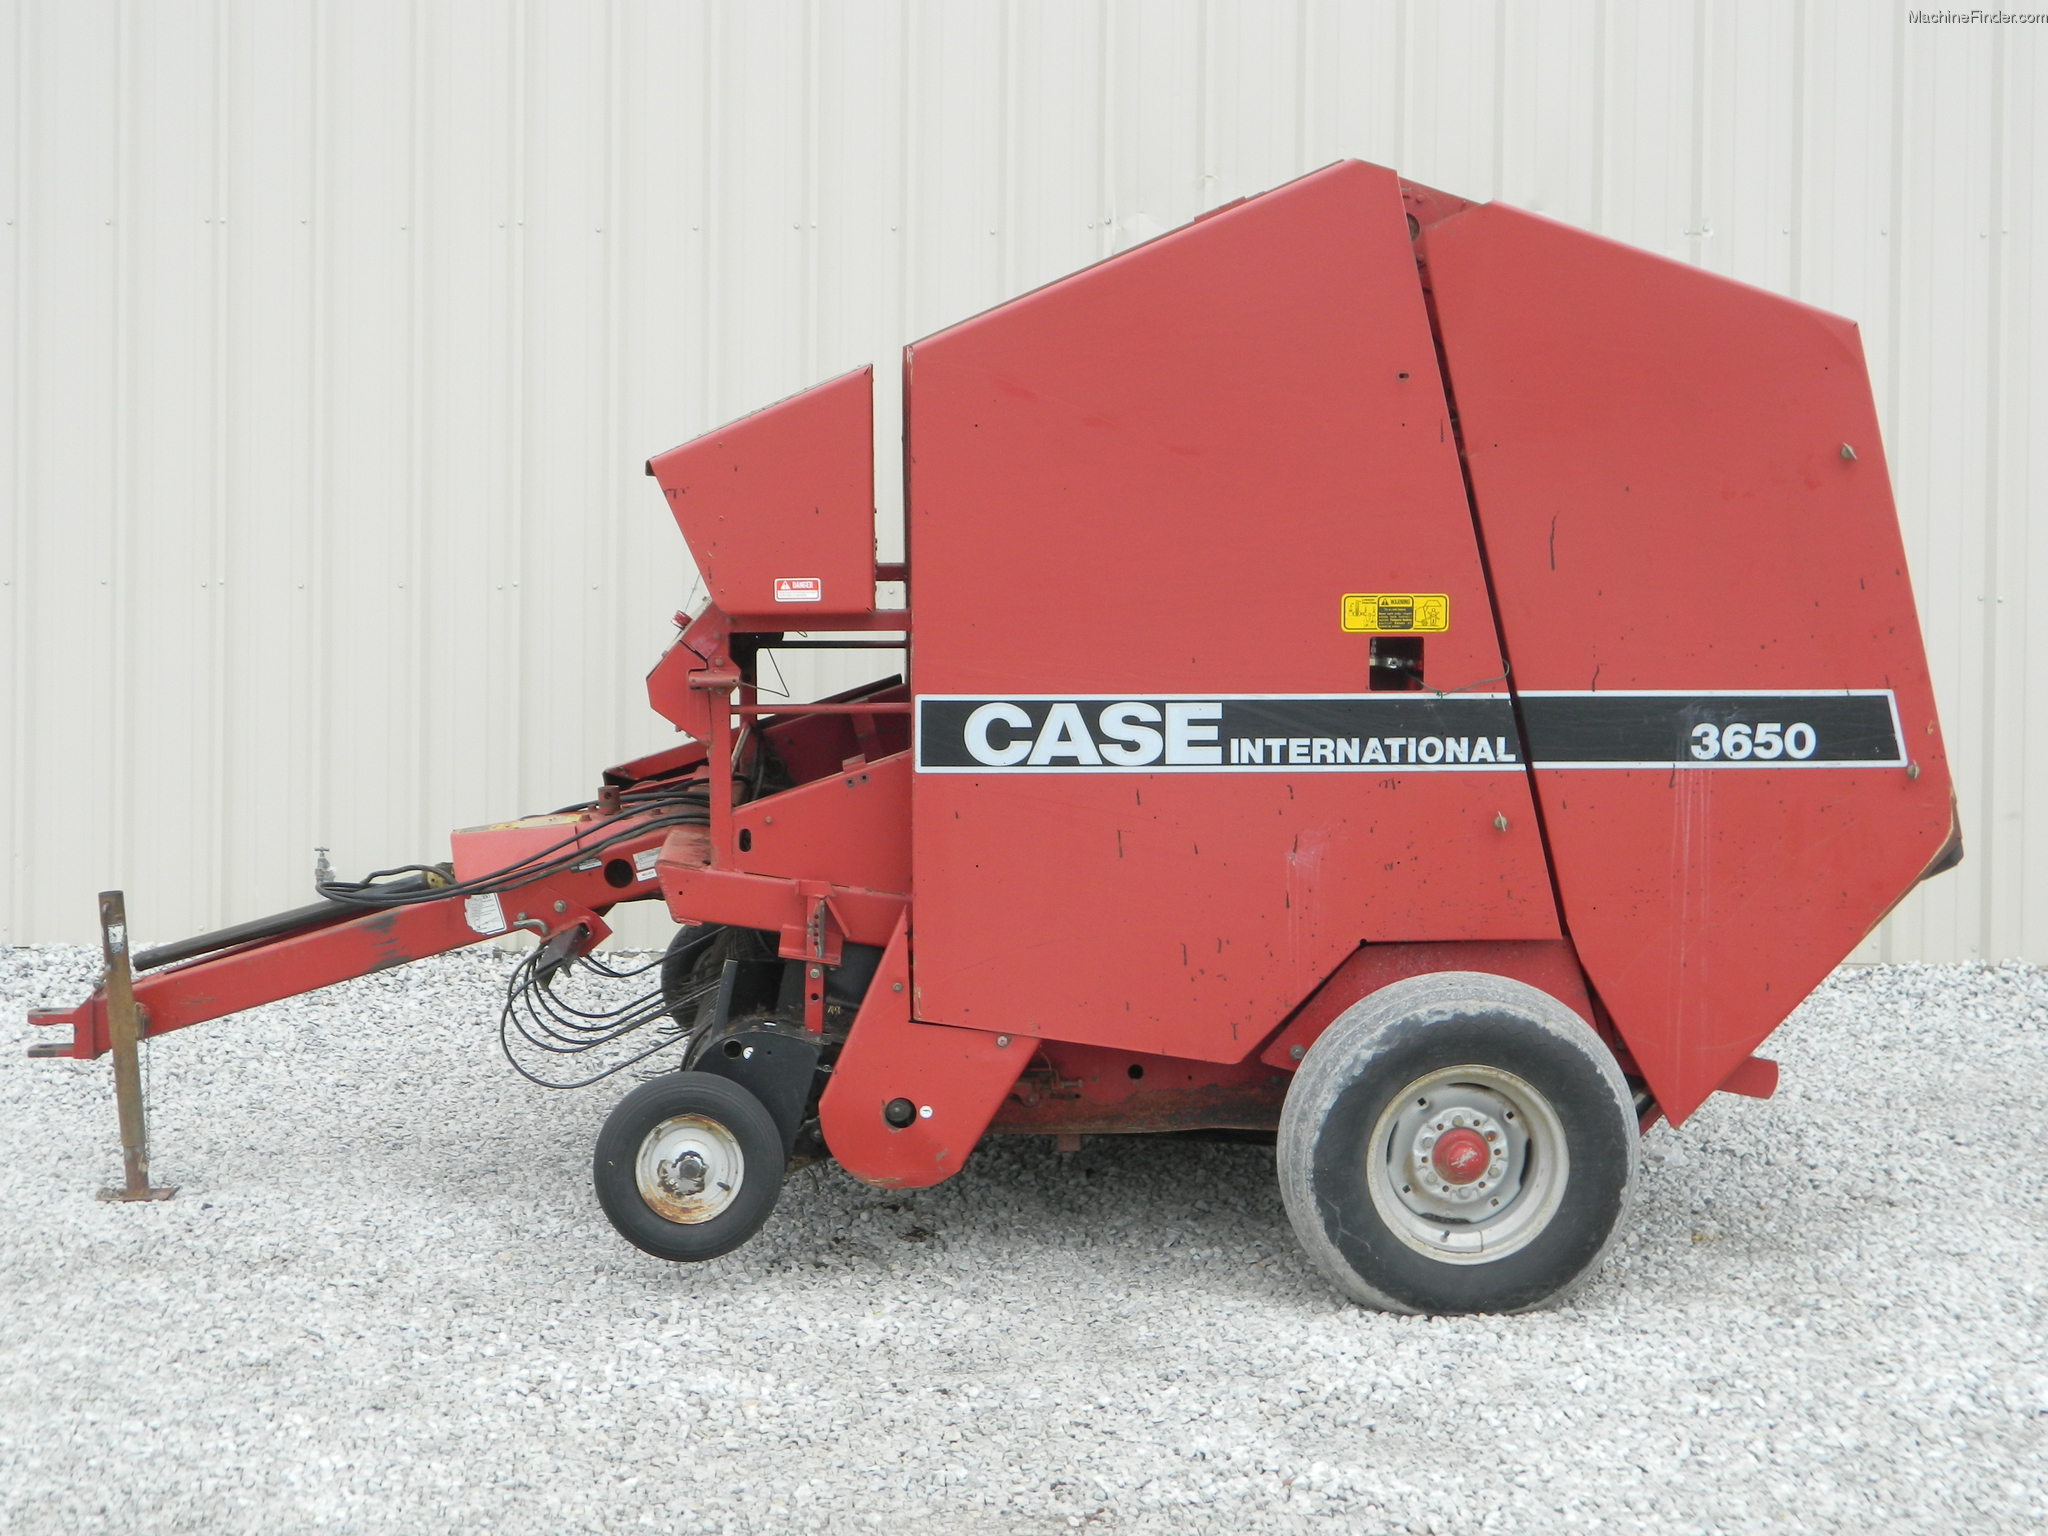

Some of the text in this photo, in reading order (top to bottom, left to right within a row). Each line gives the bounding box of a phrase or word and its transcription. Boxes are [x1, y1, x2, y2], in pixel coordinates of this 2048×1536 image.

[963, 701, 1517, 767] CASE INTERNATIONAL
[1690, 722, 1817, 760] 3650
